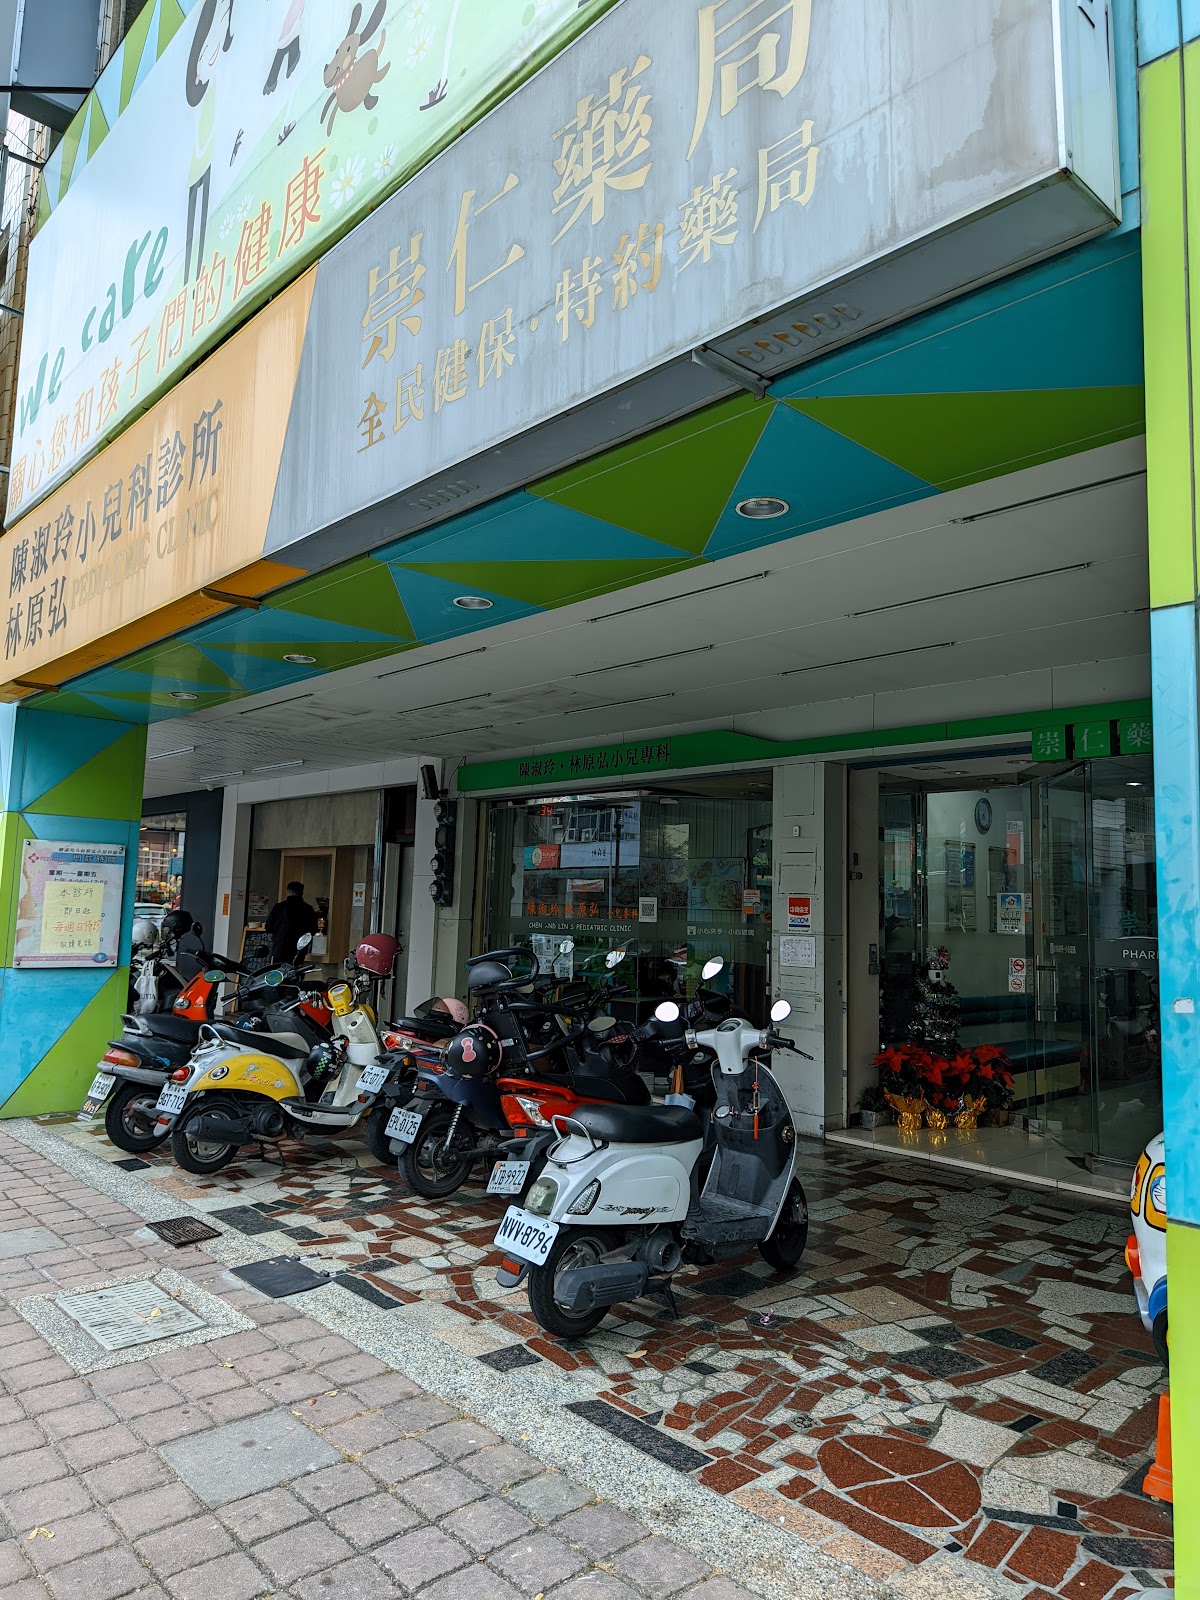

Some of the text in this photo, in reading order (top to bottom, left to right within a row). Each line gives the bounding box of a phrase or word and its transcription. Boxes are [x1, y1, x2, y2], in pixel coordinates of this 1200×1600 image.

[361, 0, 811, 370] 崇仁藥局
[9, 146, 327, 518] 關心您和孩子們的健康
[81, 226, 169, 353] care
[71, 491, 220, 611] PEDIATRIC CLINIC
[3, 575, 68, 661] 林原弘
[575, 923, 608, 931] PEDIATRIC
[1122, 949, 1157, 960] PHAR
[388, 1114, 419, 1136] EPL-0125
[500, 1214, 553, 1255] NVV-8796
